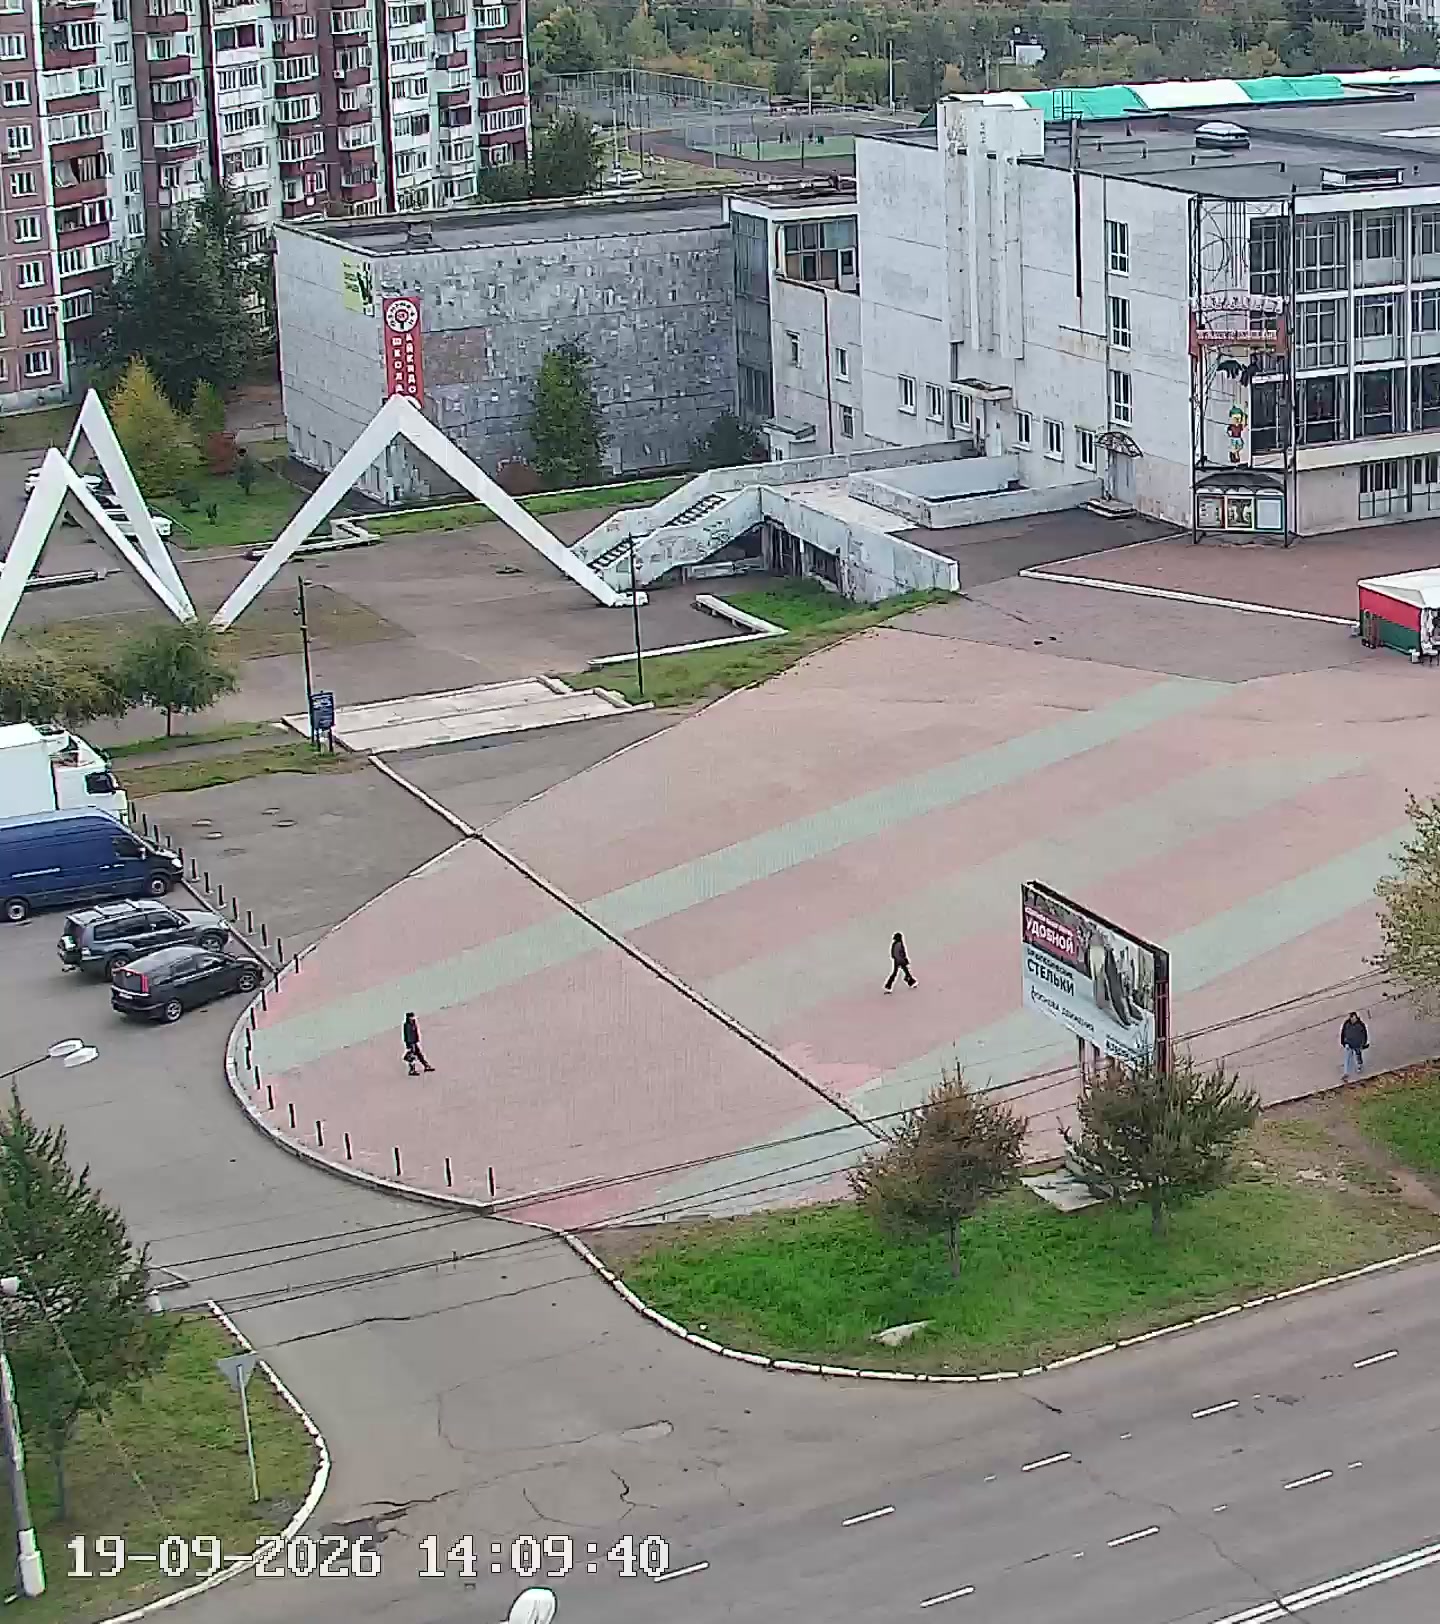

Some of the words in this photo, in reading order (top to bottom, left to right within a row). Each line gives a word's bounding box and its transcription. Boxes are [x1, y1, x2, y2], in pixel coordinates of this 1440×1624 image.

[391, 337, 404, 393] ШКОЛА
[405, 333, 417, 394] АЙКИДО
[1025, 915, 1074, 954] УДОБНОЙ
[1027, 959, 1074, 997] СТЕЛЬКИ
